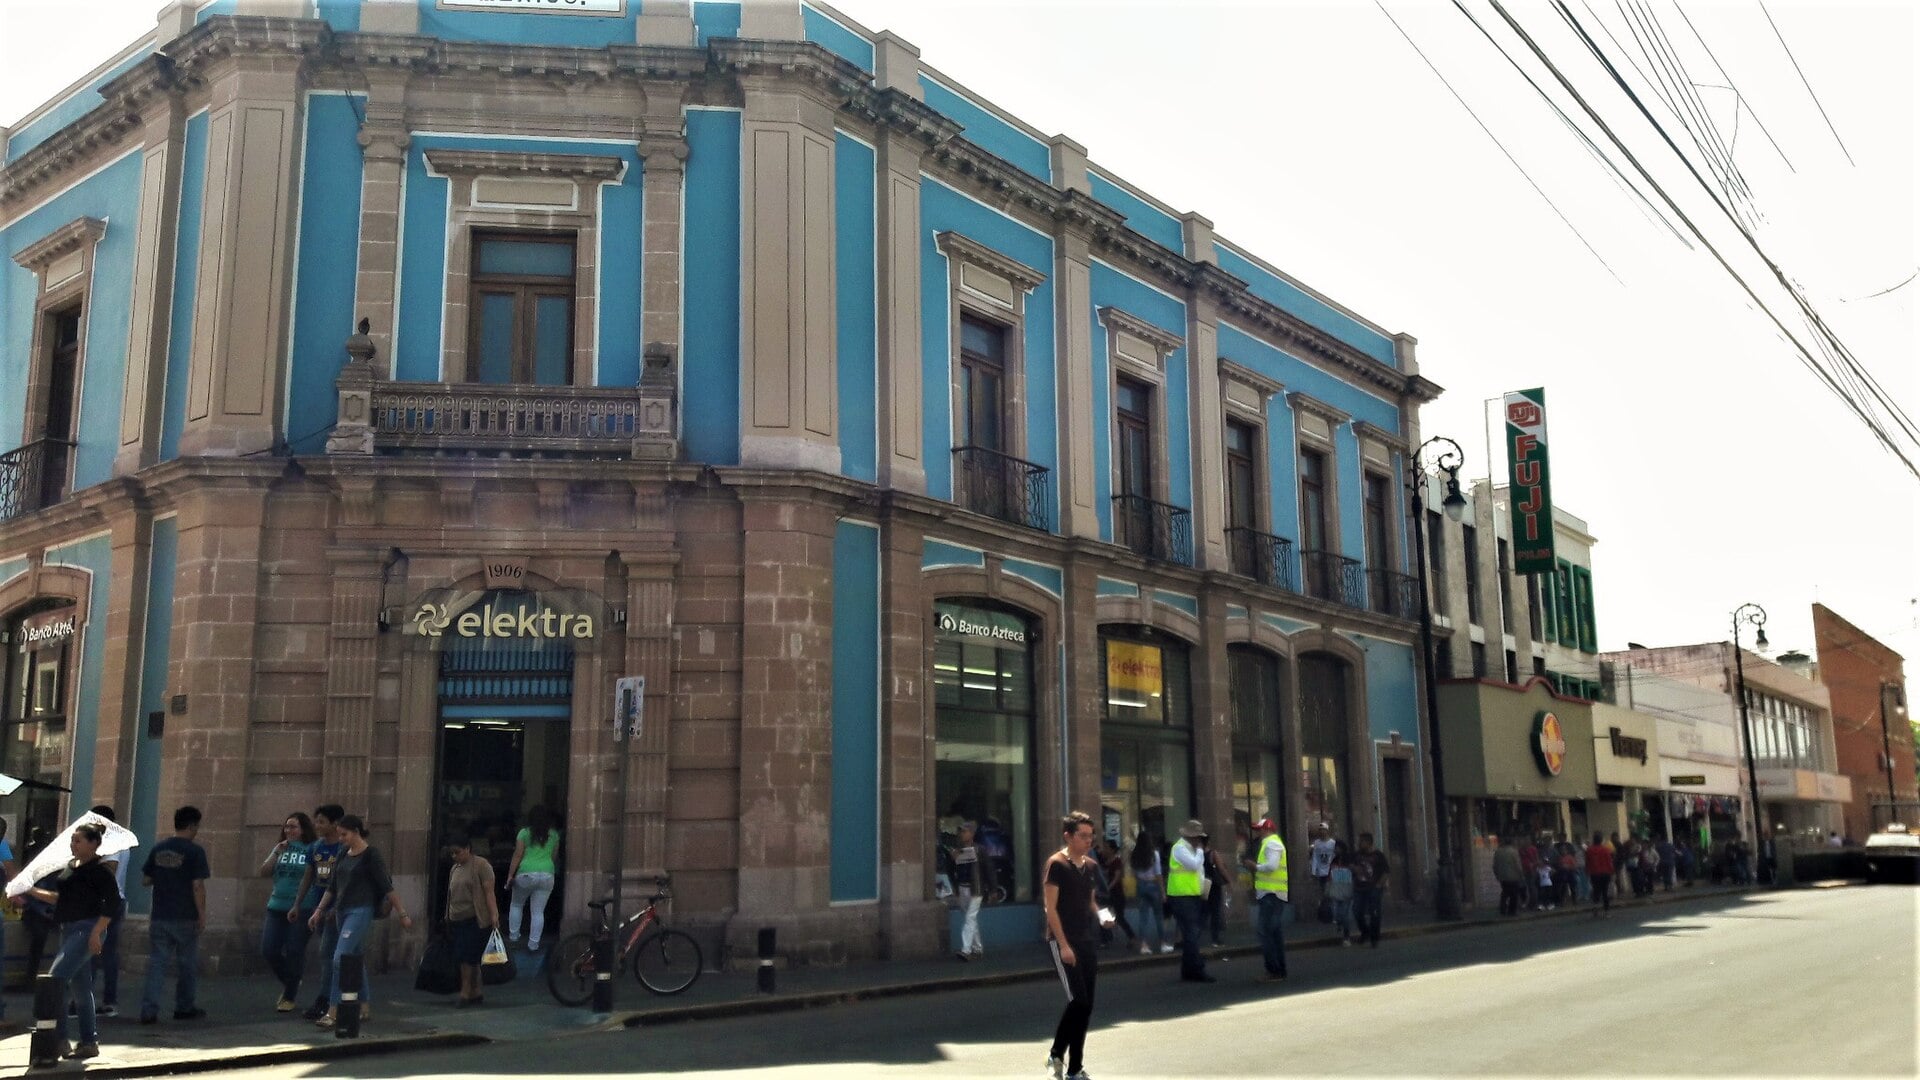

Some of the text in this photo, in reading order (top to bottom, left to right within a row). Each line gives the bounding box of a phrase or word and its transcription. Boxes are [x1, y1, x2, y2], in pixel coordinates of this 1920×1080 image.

[1516, 434, 1543, 541] FUJI
[487, 564, 523, 579] 1906
[457, 604, 594, 638] elektra
[958, 620, 1025, 642] Banco Azteca
[28, 625, 52, 642] Banco
